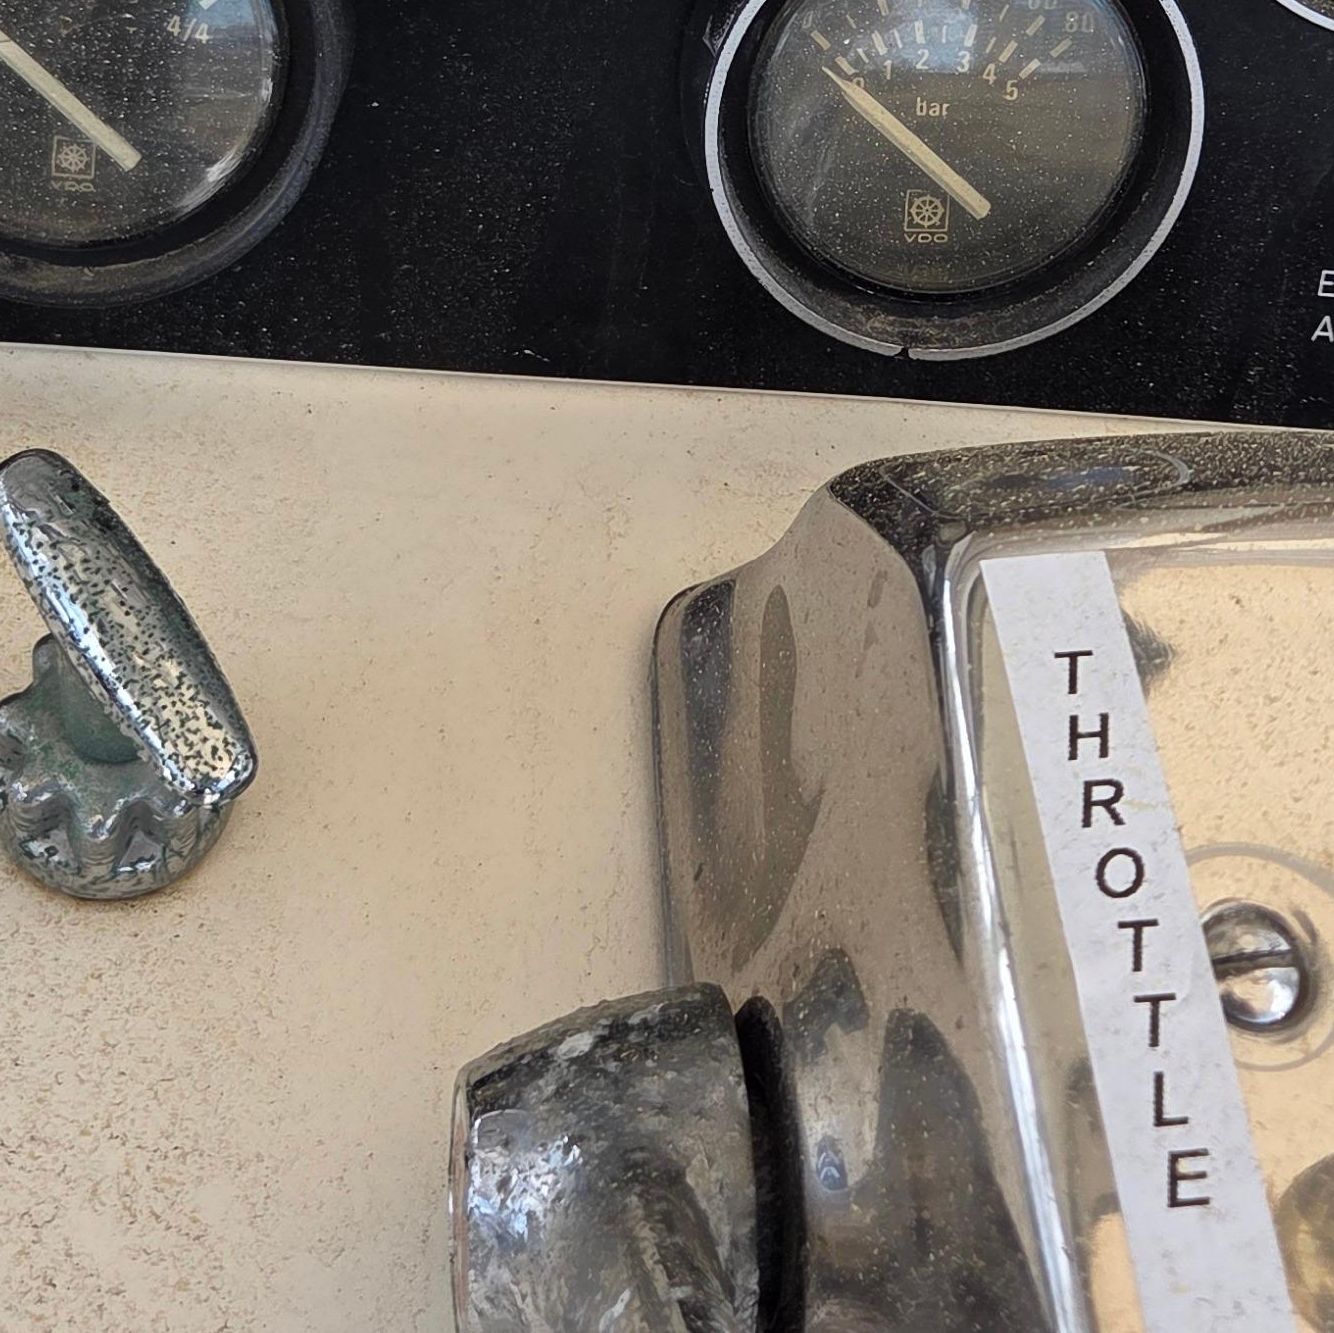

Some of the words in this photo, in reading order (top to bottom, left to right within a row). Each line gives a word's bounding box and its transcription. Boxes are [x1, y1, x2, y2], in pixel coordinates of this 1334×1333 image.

[166, 14, 211, 45] 4/4
[1064, 10, 1096, 34] 80
[883, 59, 893, 81] 1
[915, 48, 931, 70] 2
[957, 50, 972, 73] 3
[981, 62, 998, 85] 4
[1003, 79, 1020, 101] 5
[915, 96, 951, 118] bar
[904, 232, 949, 244] VDO
[1053, 649, 1211, 1210] THROTTLE
